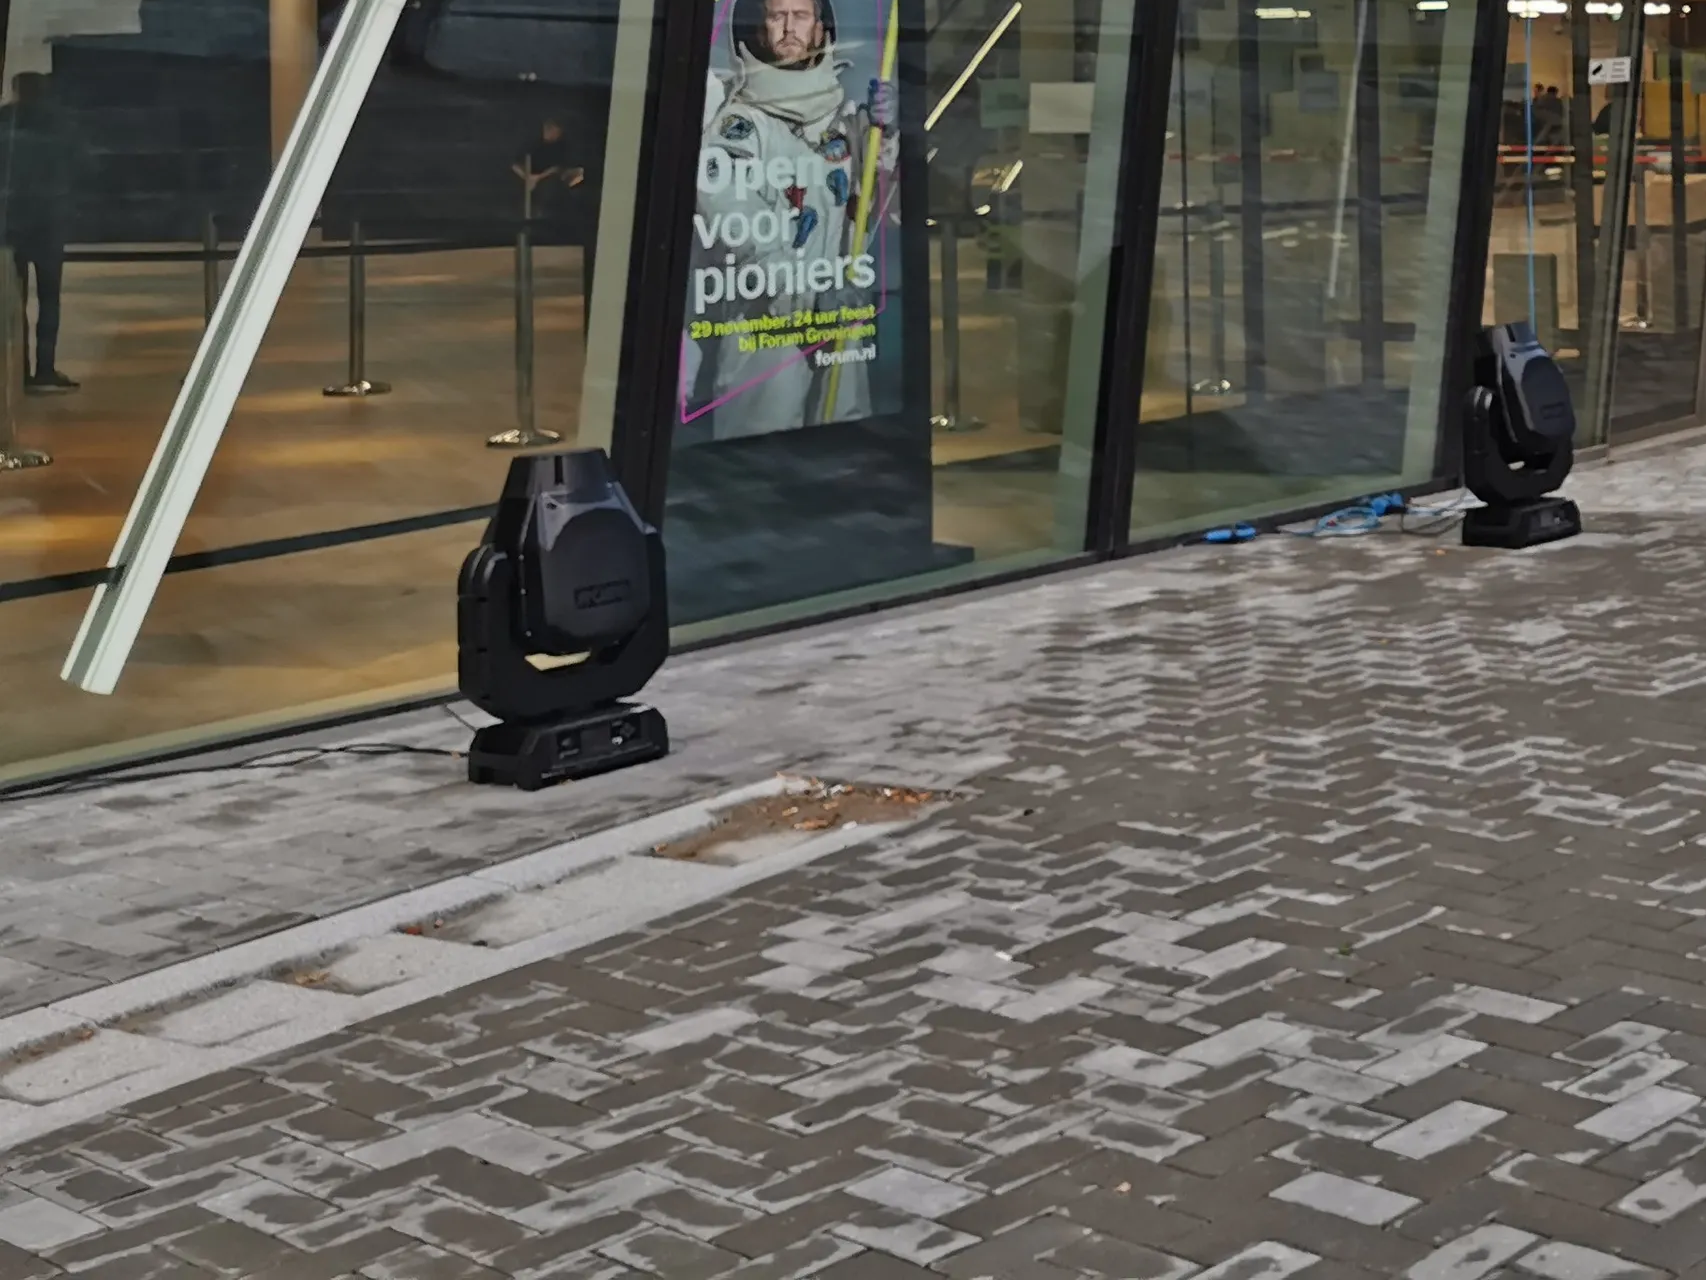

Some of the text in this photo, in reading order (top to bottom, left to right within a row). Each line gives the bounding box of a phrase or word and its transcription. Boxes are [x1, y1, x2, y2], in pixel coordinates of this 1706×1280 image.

[697, 146, 825, 200] Open
[693, 206, 800, 250] voor
[694, 247, 876, 314] pioniers
[793, 309, 812, 327] 24
[759, 328, 804, 350] Forum
[815, 344, 876, 367] forum.nl
